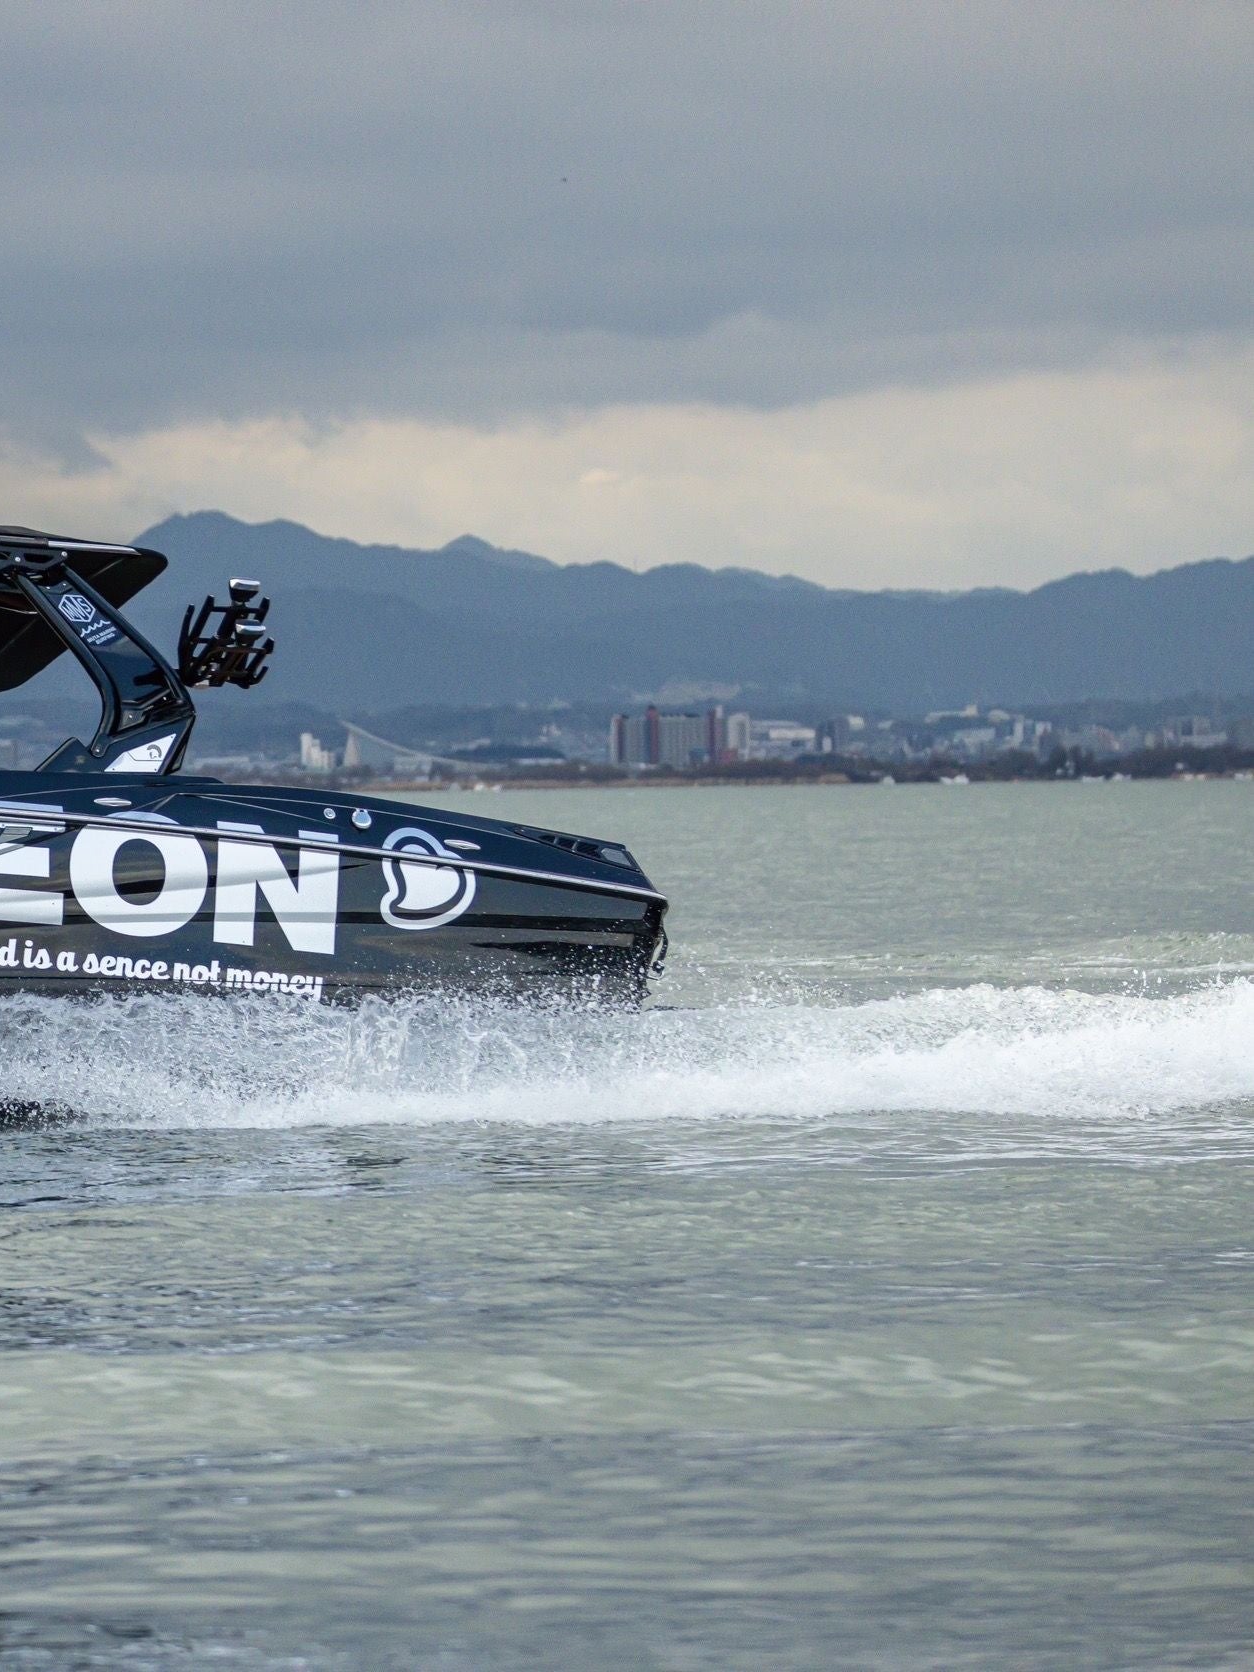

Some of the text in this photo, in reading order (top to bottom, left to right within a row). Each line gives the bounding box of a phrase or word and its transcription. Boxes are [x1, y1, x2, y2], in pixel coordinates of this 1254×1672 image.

[23, 940, 52, 969] is
[56, 951, 79, 972] a
[82, 953, 170, 980] sence
[173, 960, 222, 986] not
[227, 967, 323, 1001] money
